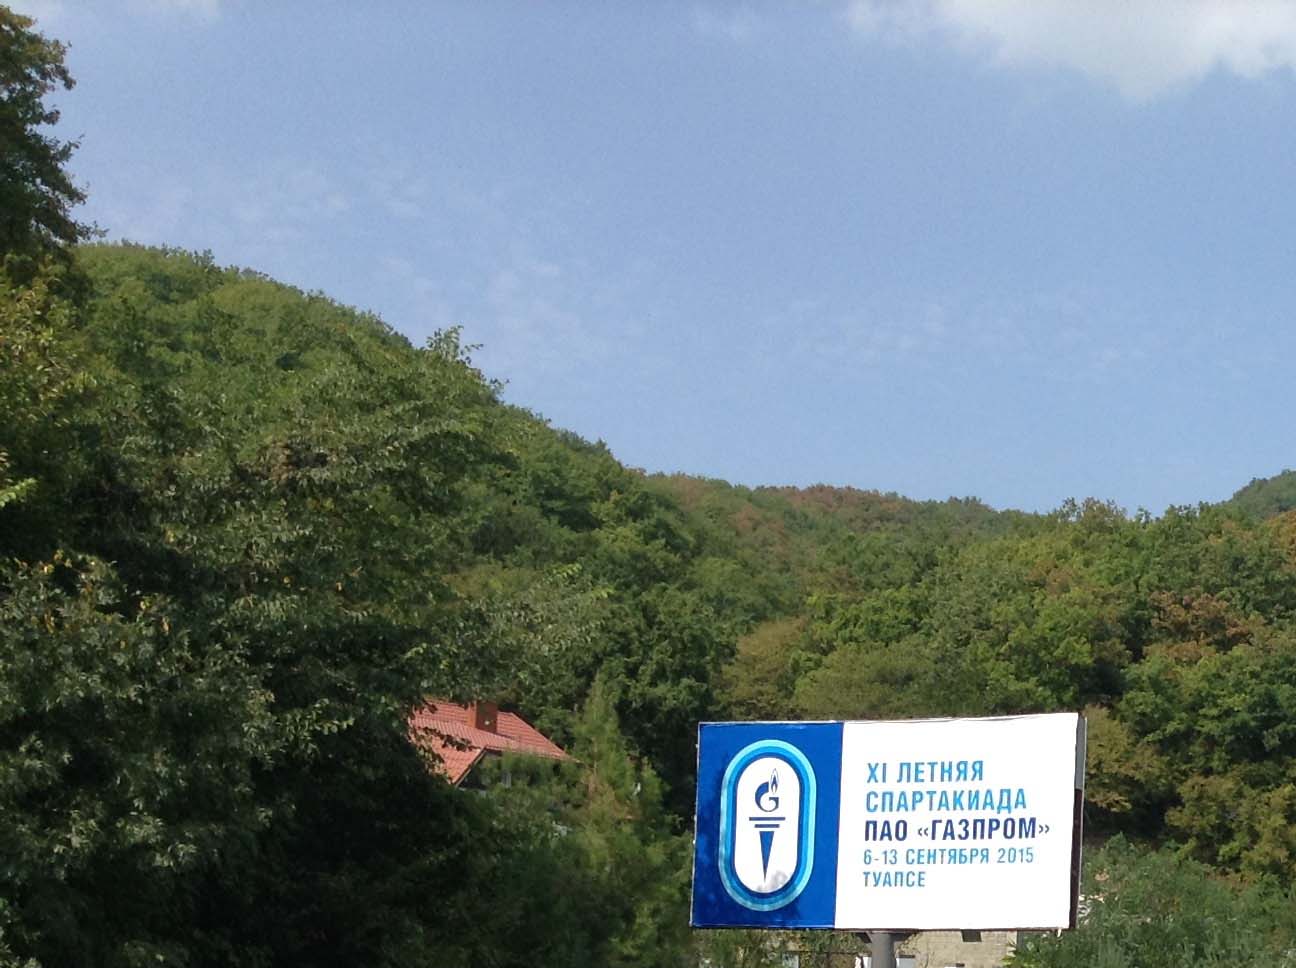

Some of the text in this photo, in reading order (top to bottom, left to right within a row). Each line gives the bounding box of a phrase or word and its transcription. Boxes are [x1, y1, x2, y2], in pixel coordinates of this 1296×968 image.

[896, 760, 984, 783] ЛЕТНЯЯ
[866, 788, 1027, 814] СПАРТАКИАДА
[865, 817, 1050, 841] ПАО «ГАЗПРОМ»
[863, 847, 1034, 865] 6-13 СЕНТЯБРЯ 2015
[862, 871, 926, 887] ТУАПСЕ
